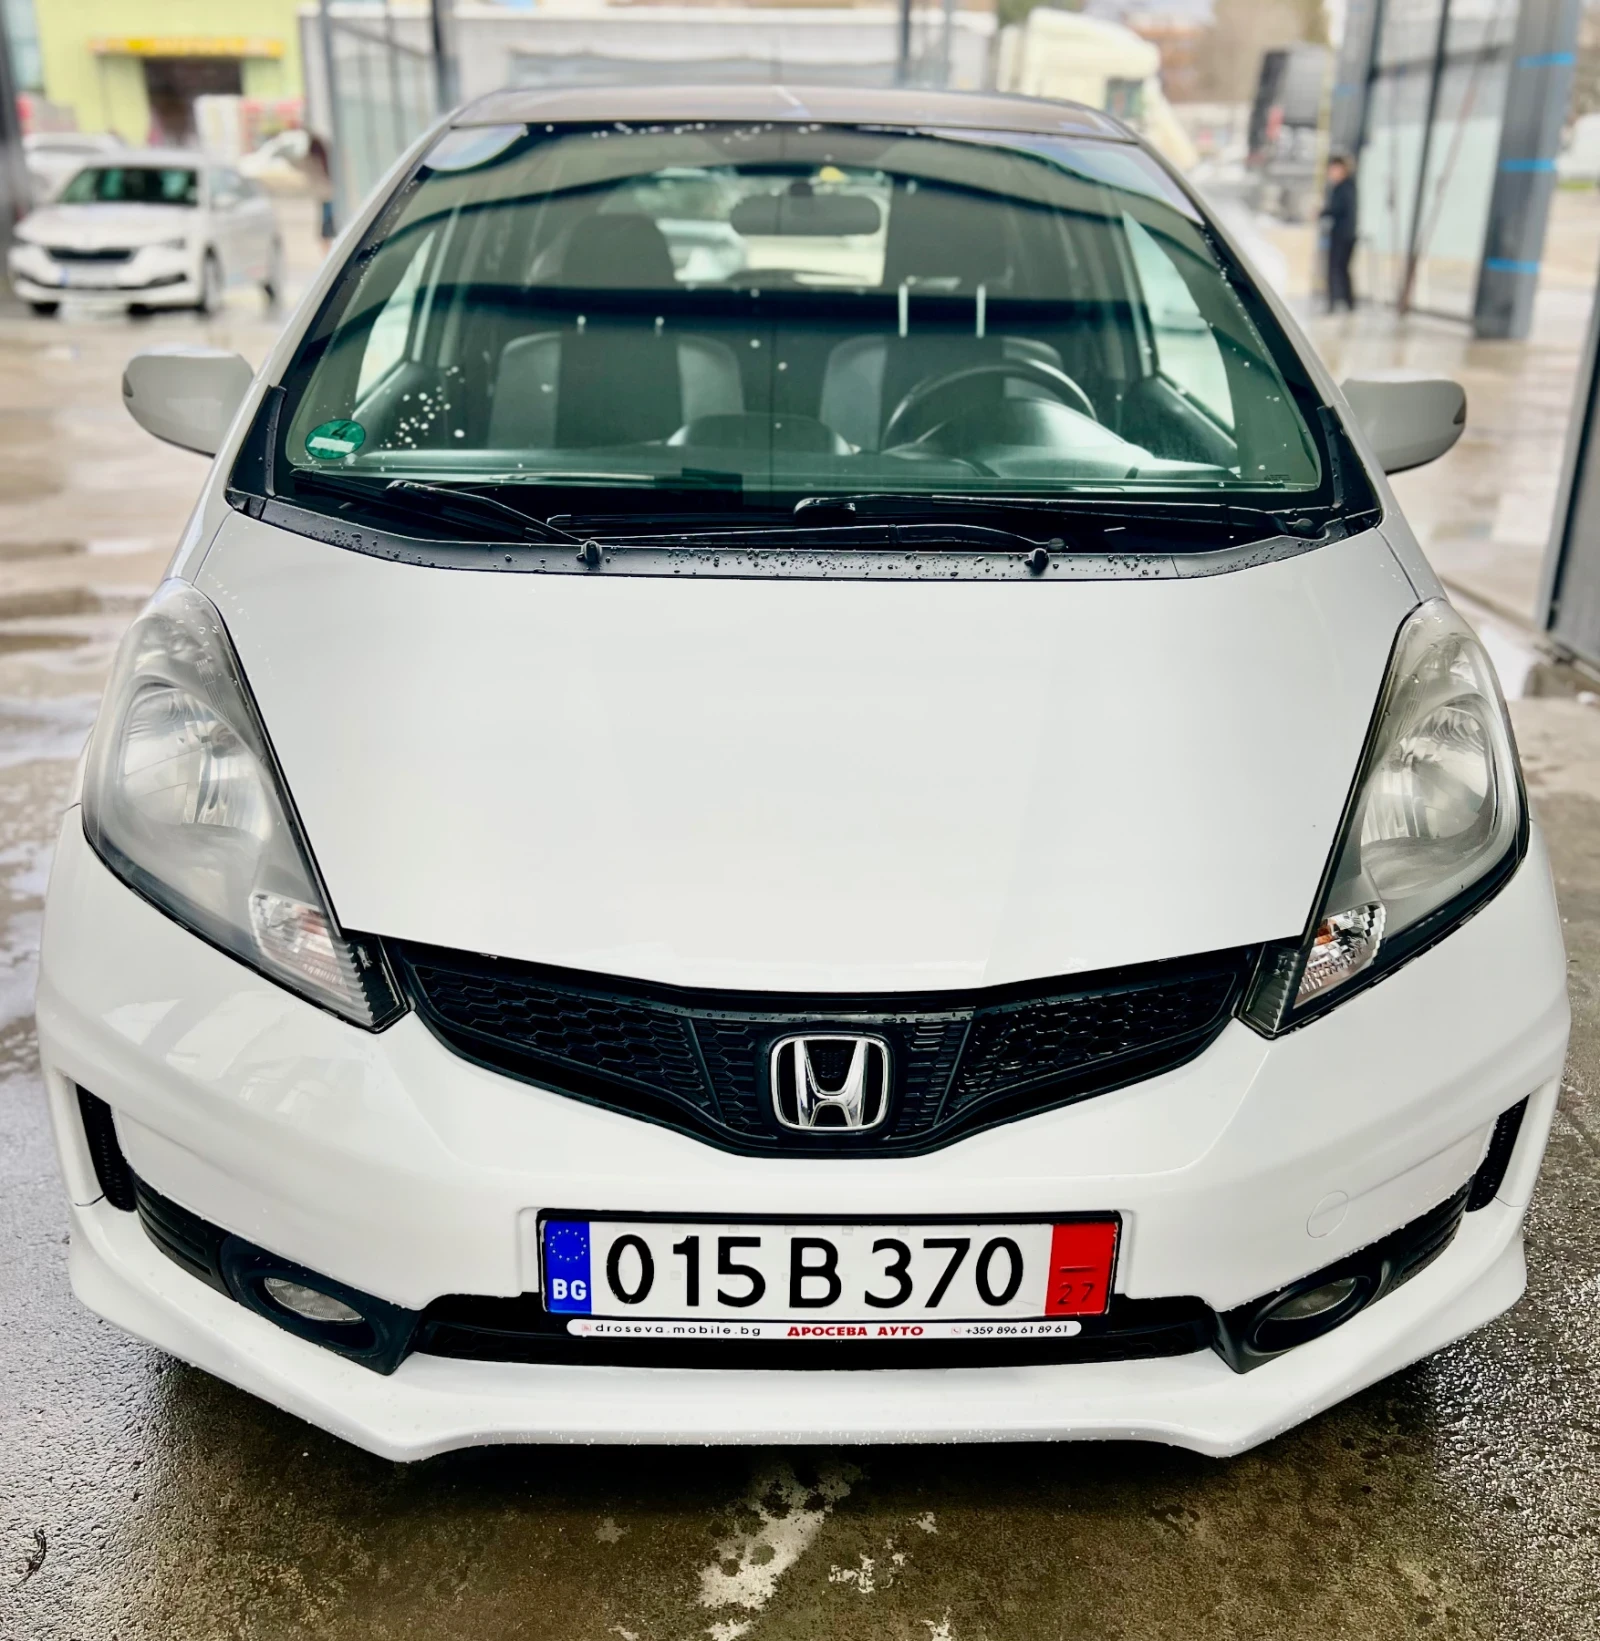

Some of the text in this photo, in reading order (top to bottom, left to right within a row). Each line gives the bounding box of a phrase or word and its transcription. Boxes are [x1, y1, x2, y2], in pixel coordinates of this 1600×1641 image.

[331, 422, 351, 440] 4
[606, 1234, 1024, 1309] 015 B 370
[552, 1278, 587, 1301] BG
[1056, 1281, 1095, 1305] 27
[595, 1323, 761, 1337] droseva.mobile.bg
[787, 1326, 924, 1337] ДРОСЕВА АУТО
[965, 1325, 1068, 1335] +359 896 61 89 61
